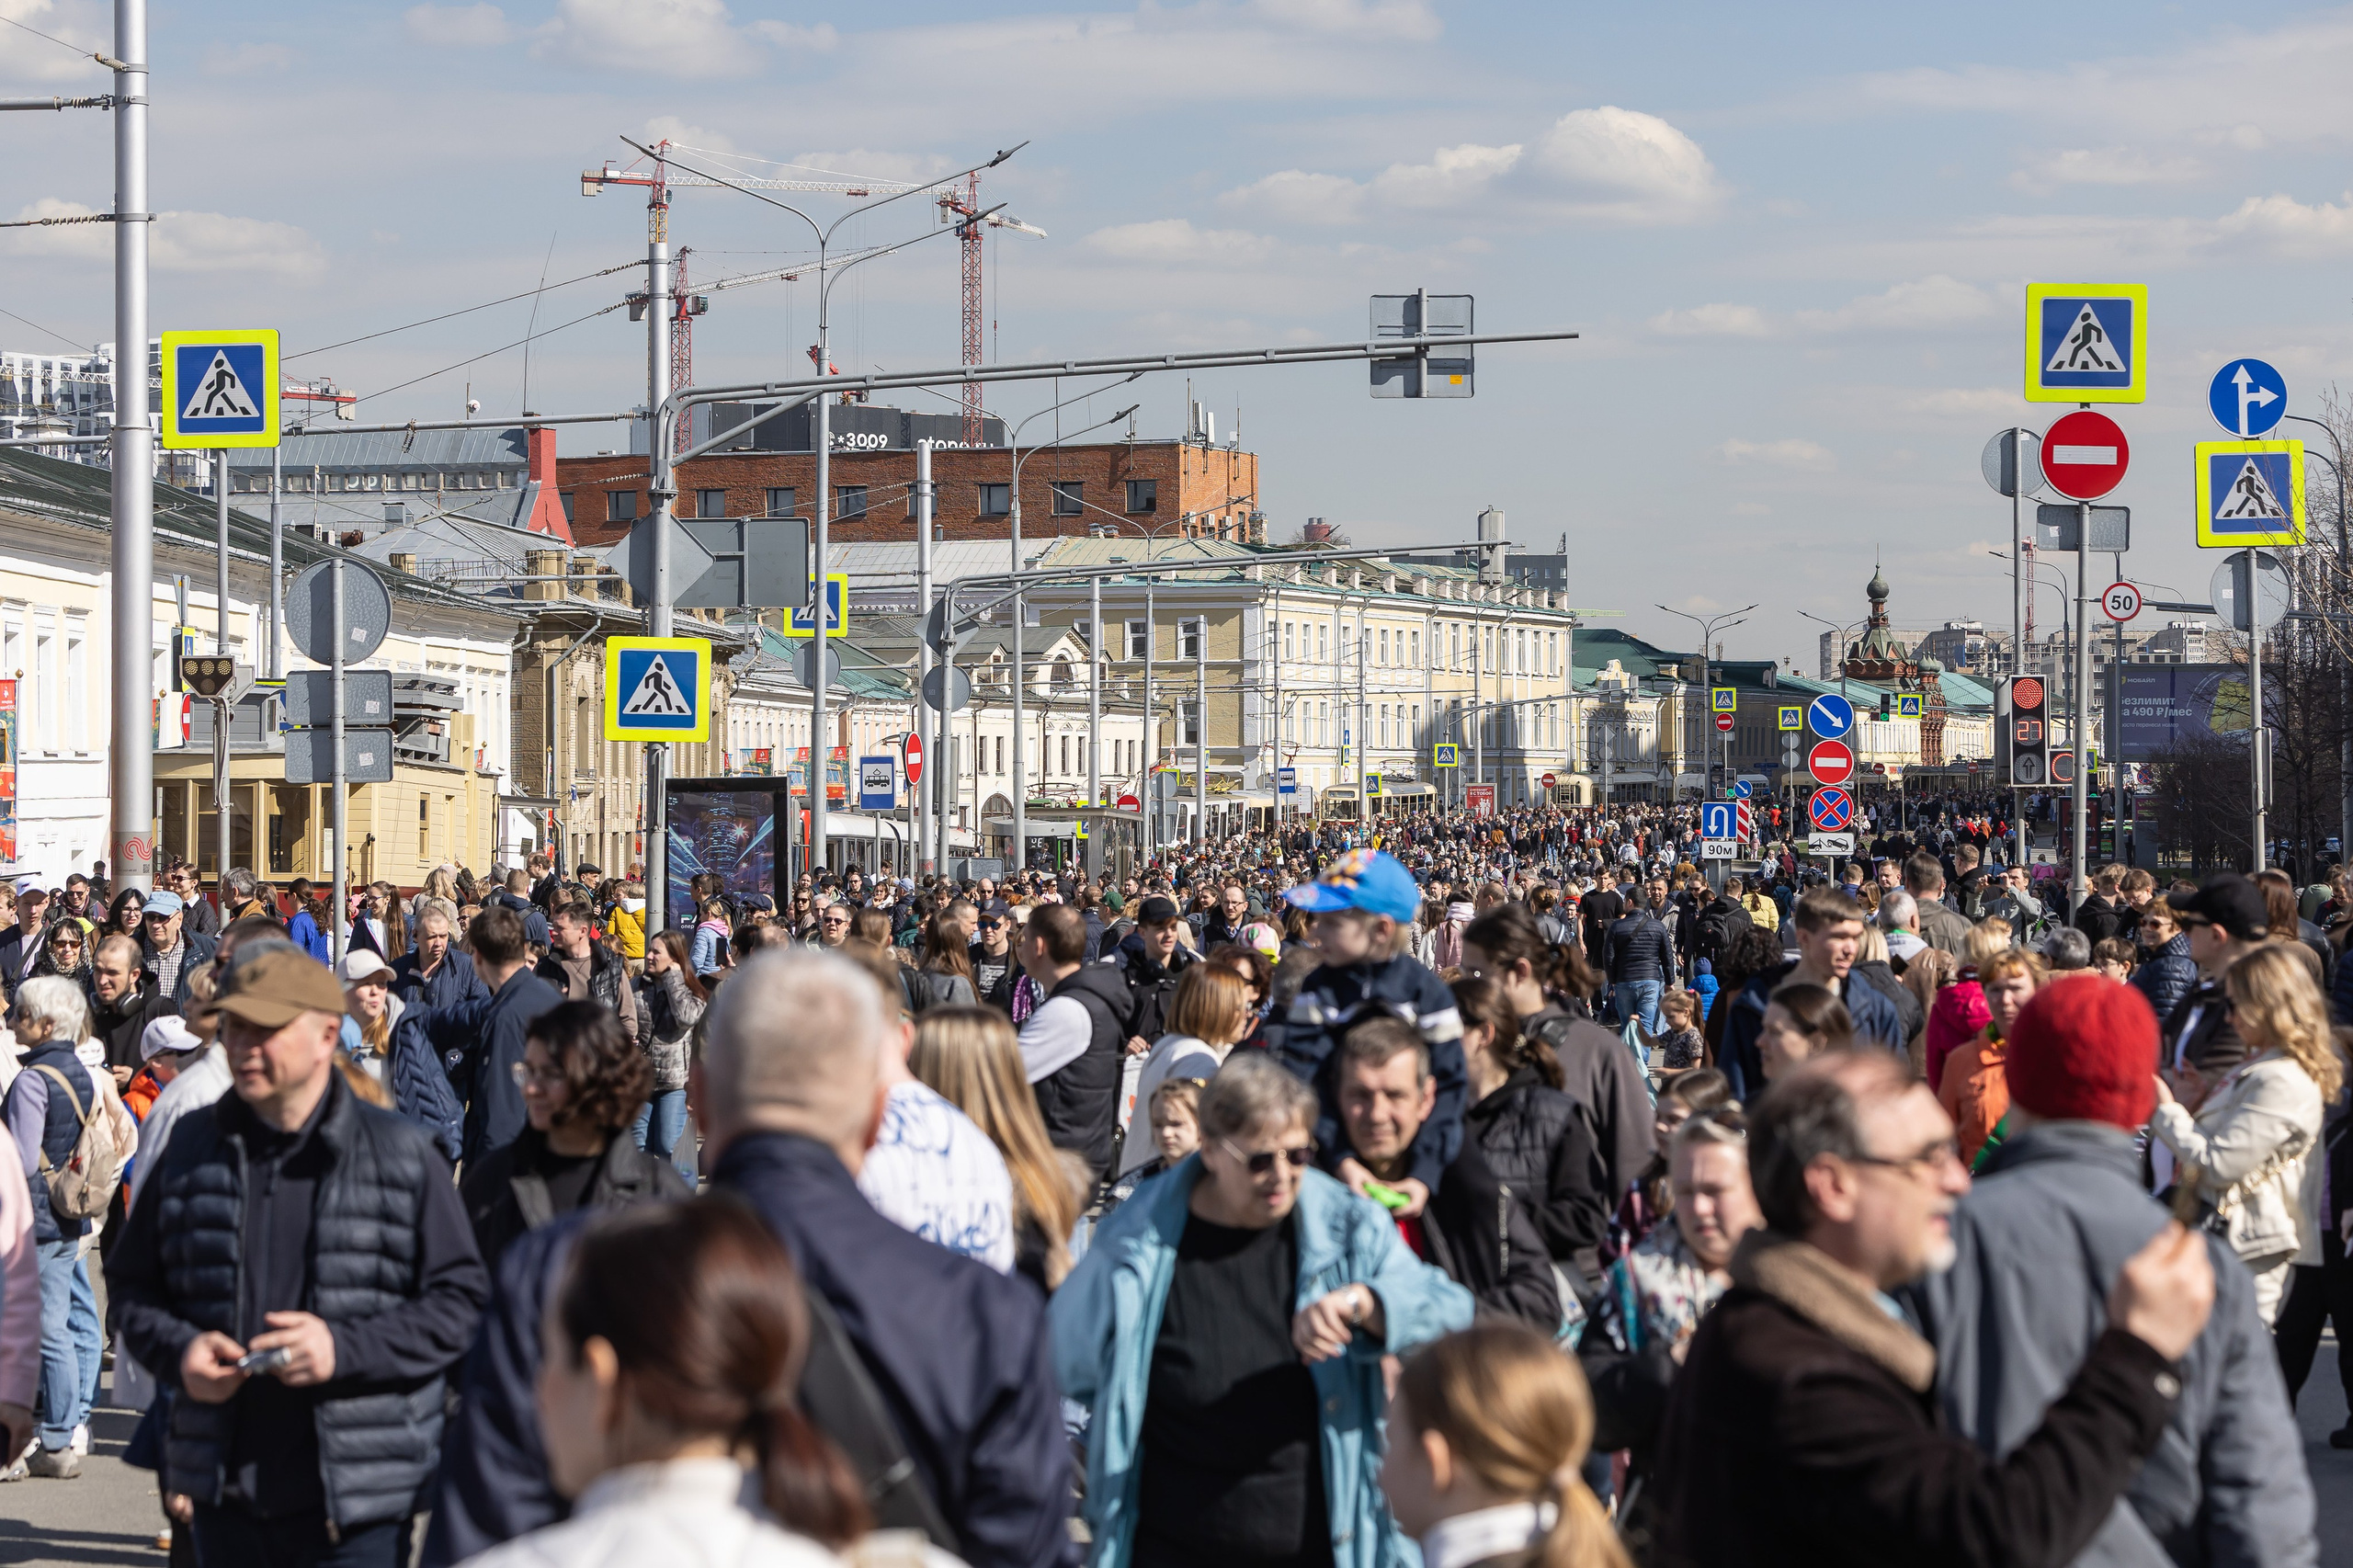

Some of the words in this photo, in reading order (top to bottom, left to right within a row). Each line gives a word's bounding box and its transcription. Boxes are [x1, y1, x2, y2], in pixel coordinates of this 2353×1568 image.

[2110, 595, 2133, 611] 50
[2132, 707, 2154, 716] 490
[2017, 721, 2041, 741] 27
